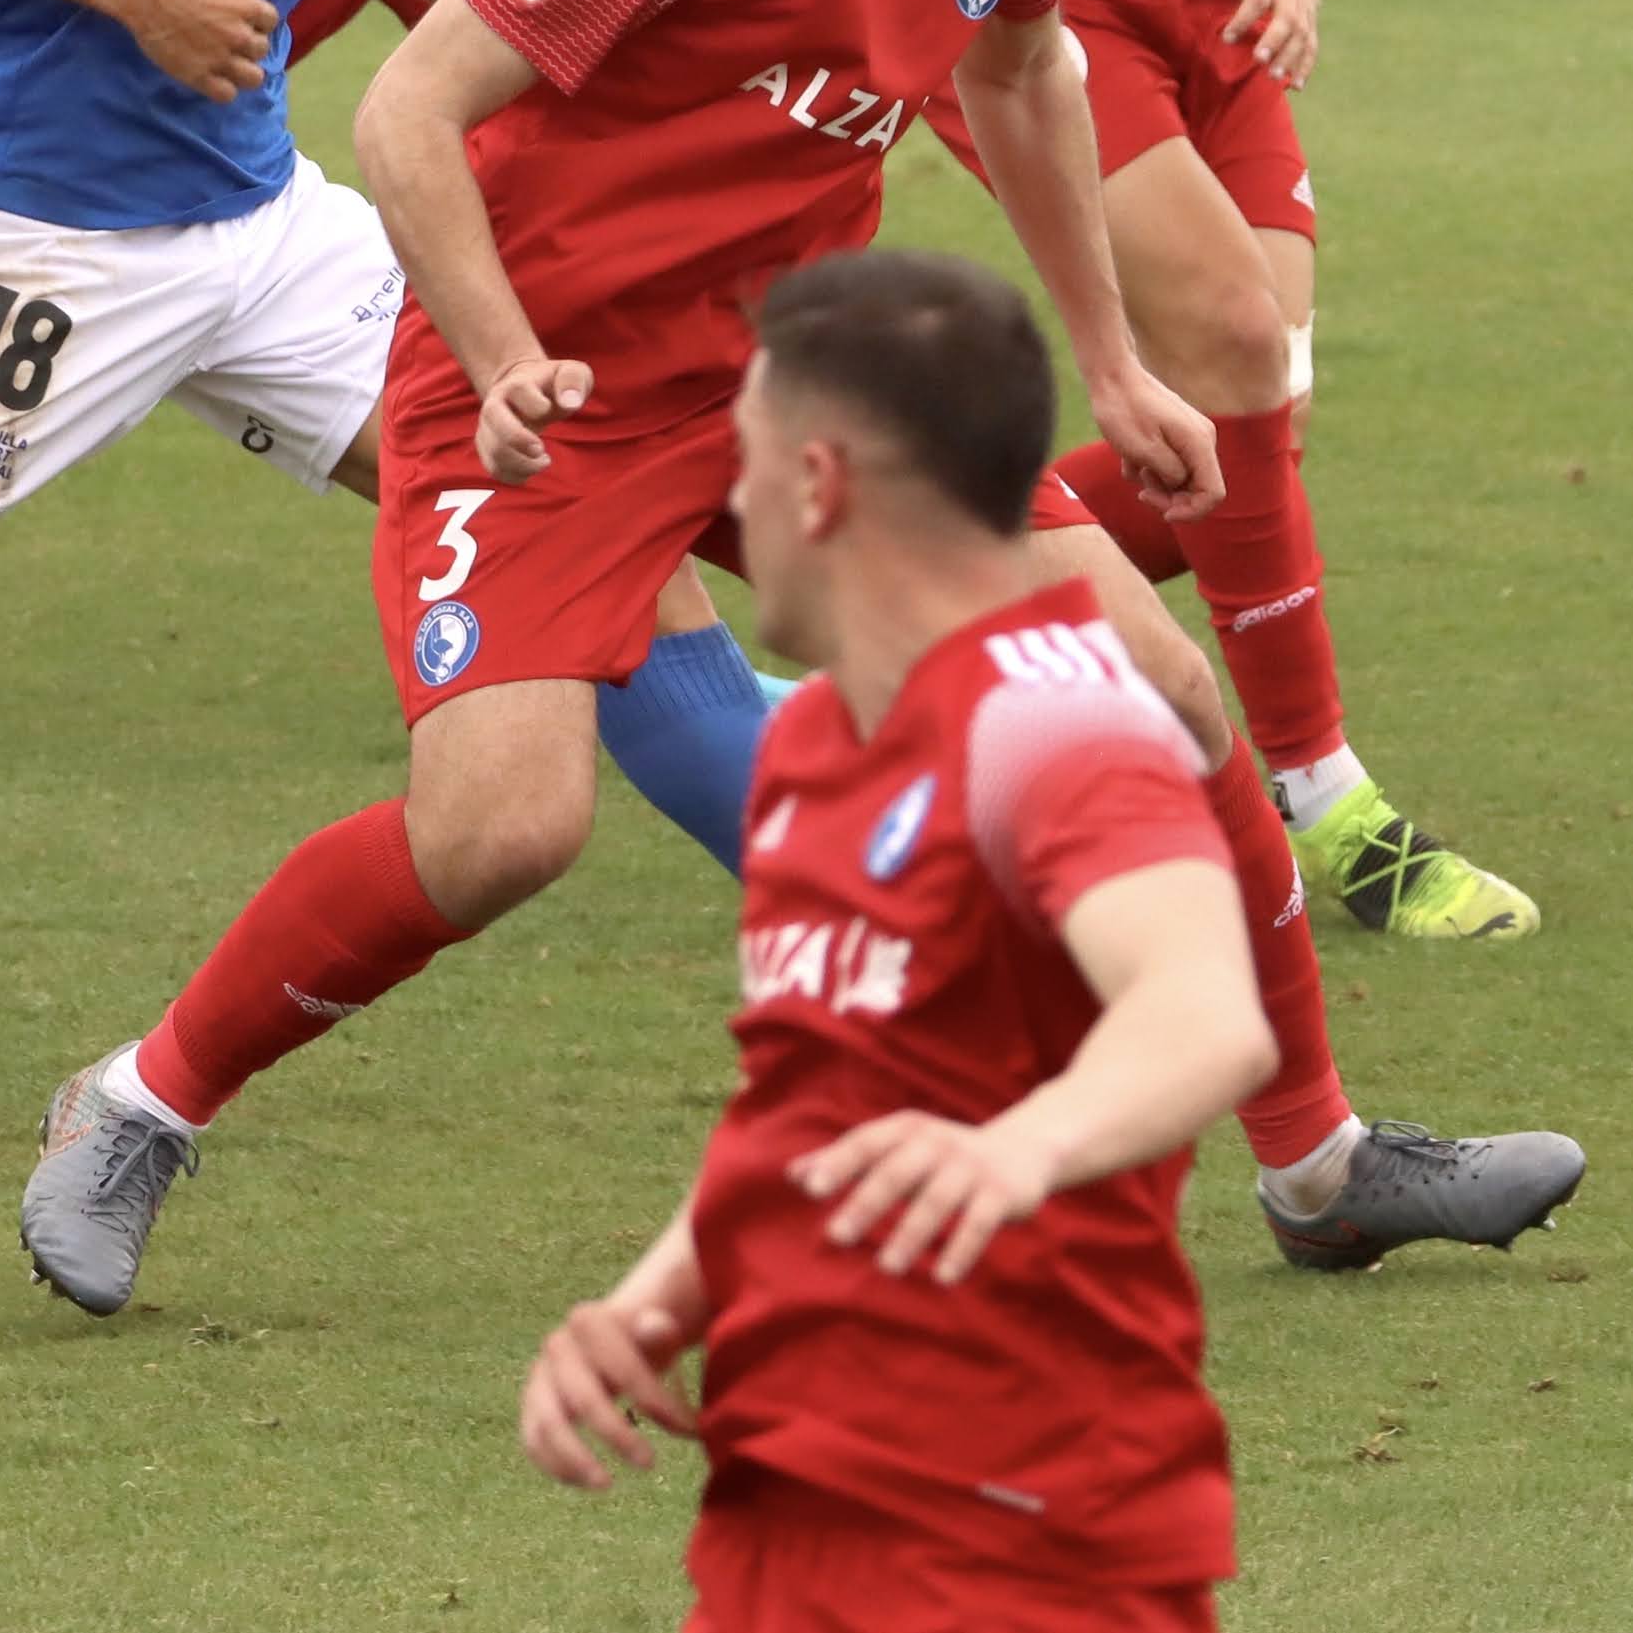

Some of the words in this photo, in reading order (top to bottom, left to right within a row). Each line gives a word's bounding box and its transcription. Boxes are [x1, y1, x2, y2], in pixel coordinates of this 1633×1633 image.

[738, 62, 904, 152] ALZA
[418, 488, 496, 602] 3
[1233, 585, 1317, 633] adidas
